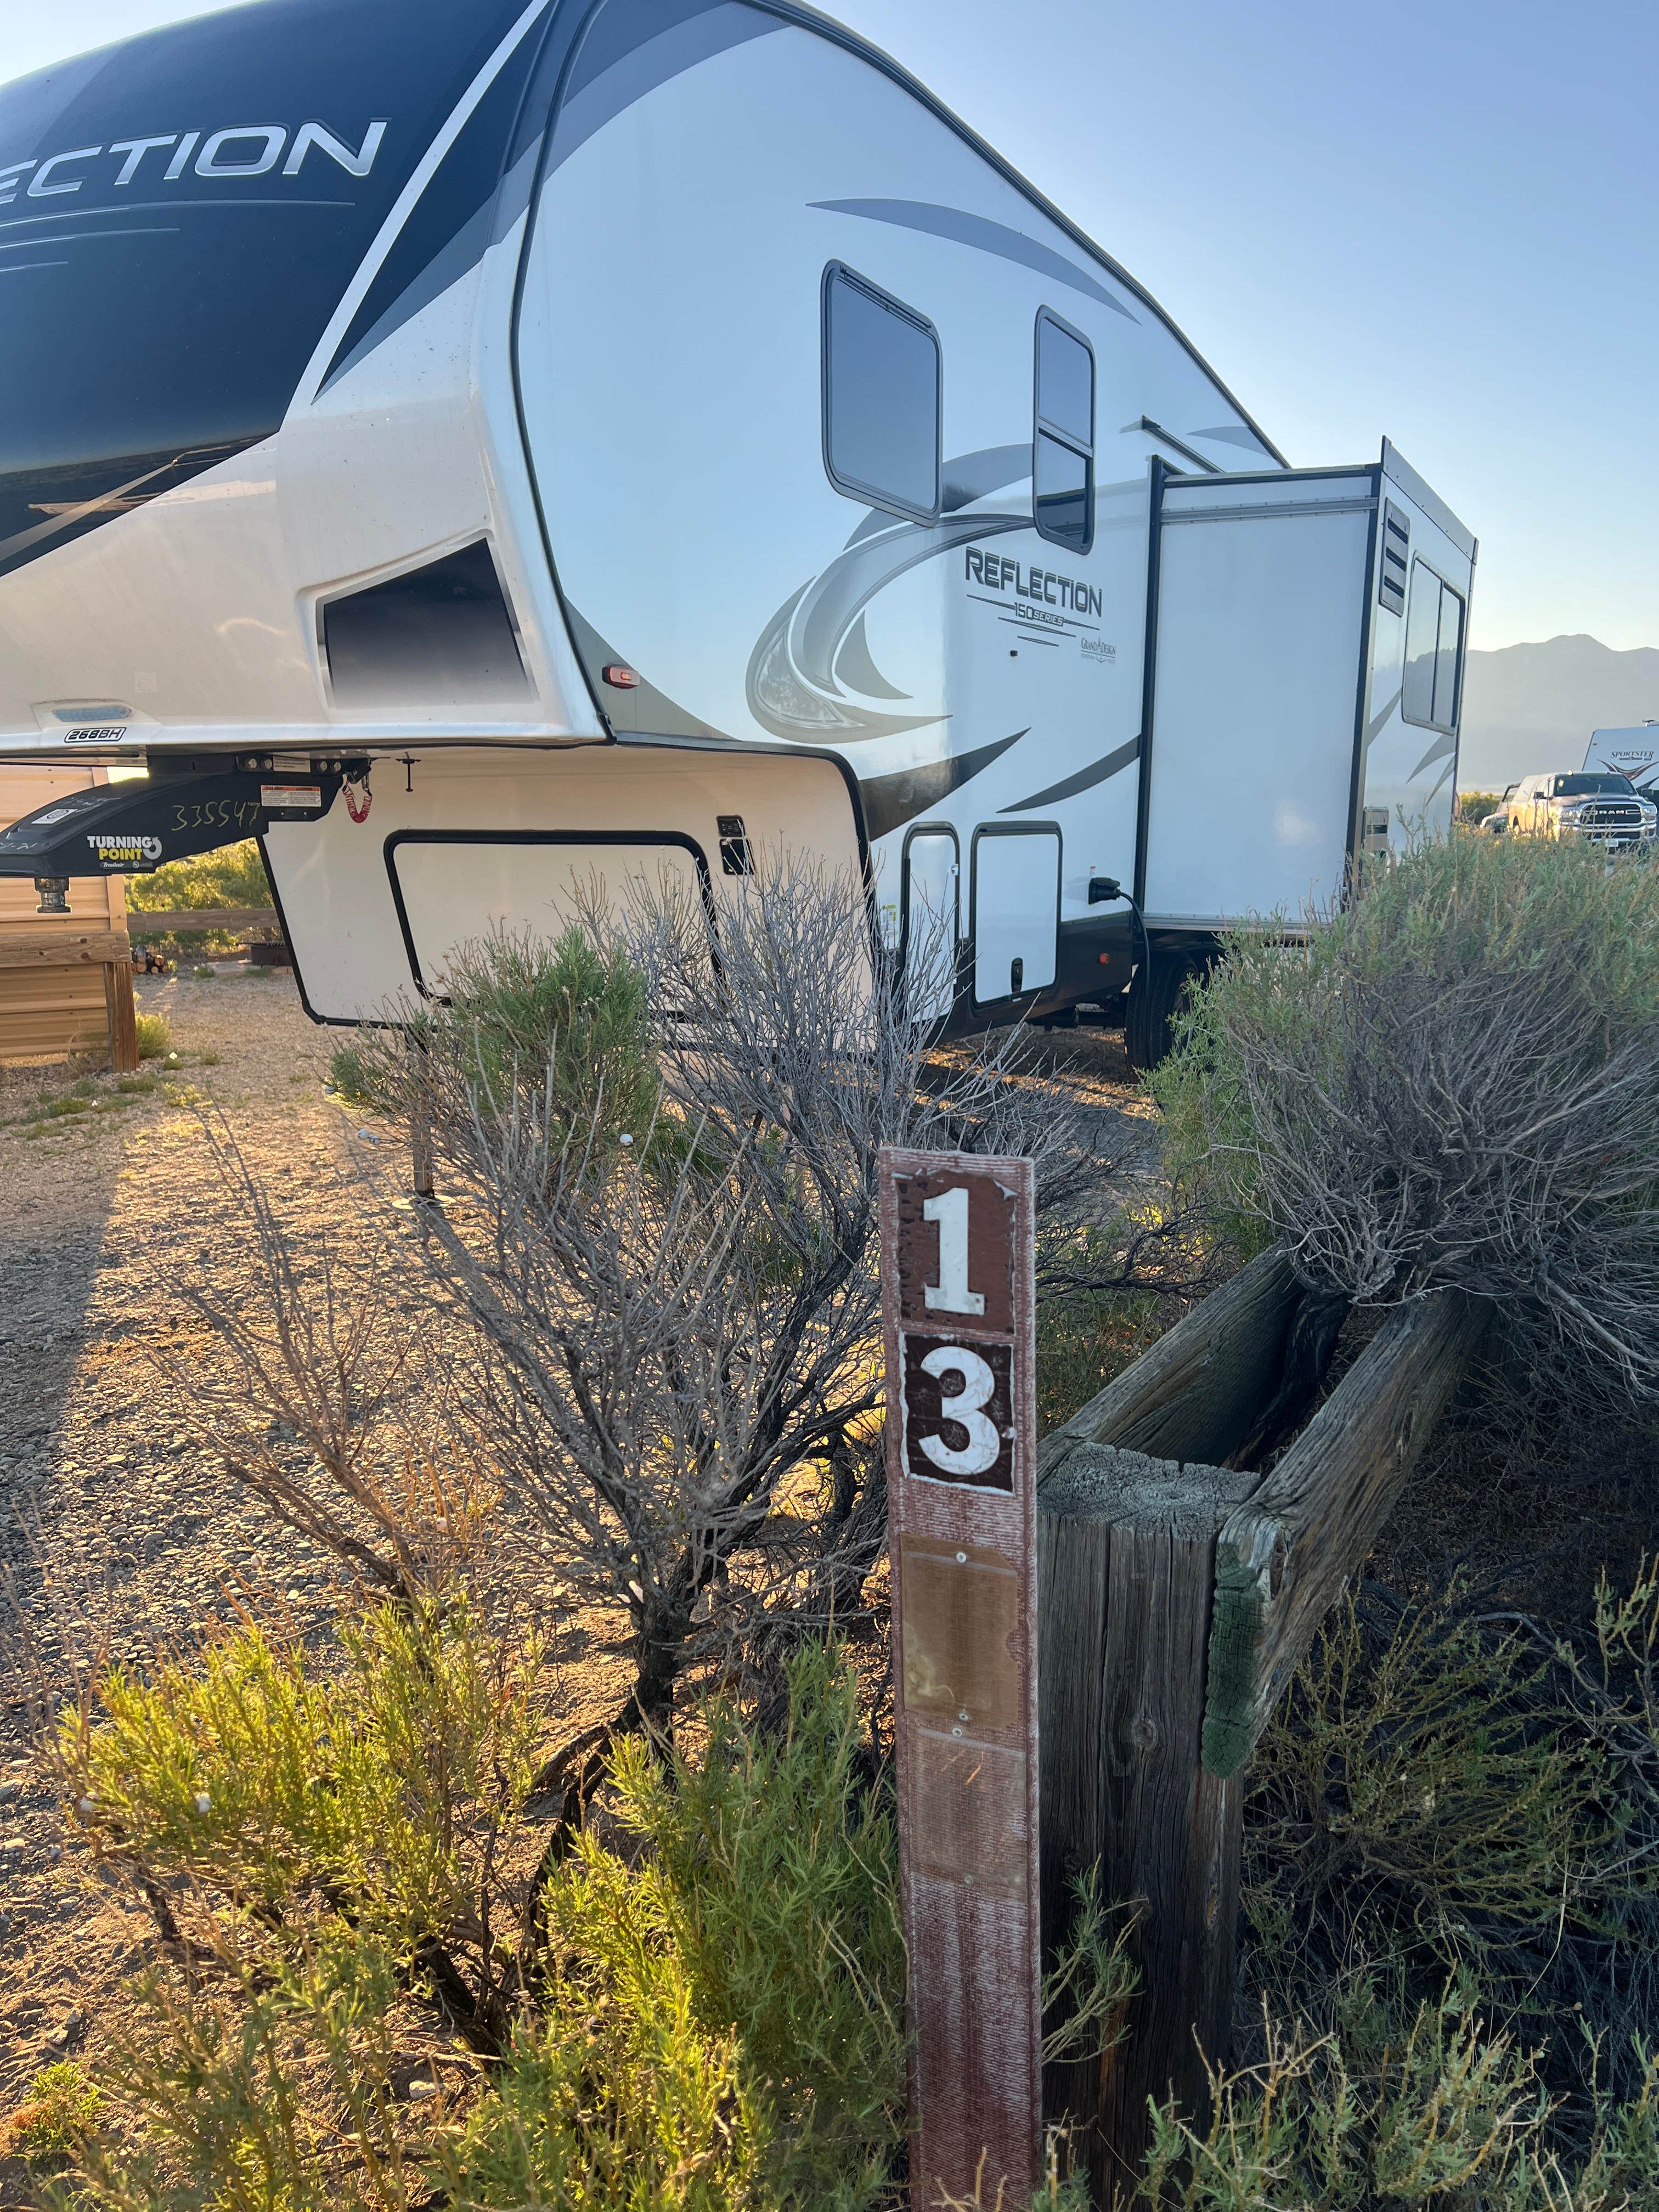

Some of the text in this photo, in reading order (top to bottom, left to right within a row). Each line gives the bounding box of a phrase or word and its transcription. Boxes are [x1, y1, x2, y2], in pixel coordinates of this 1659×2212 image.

[966, 546, 1102, 617] REFLECTION
[1033, 610, 1064, 626] SERIES
[67, 729, 122, 740] 268BH
[171, 799, 261, 831] 335547
[87, 836, 153, 848] TURNING
[99, 848, 142, 860] POINT
